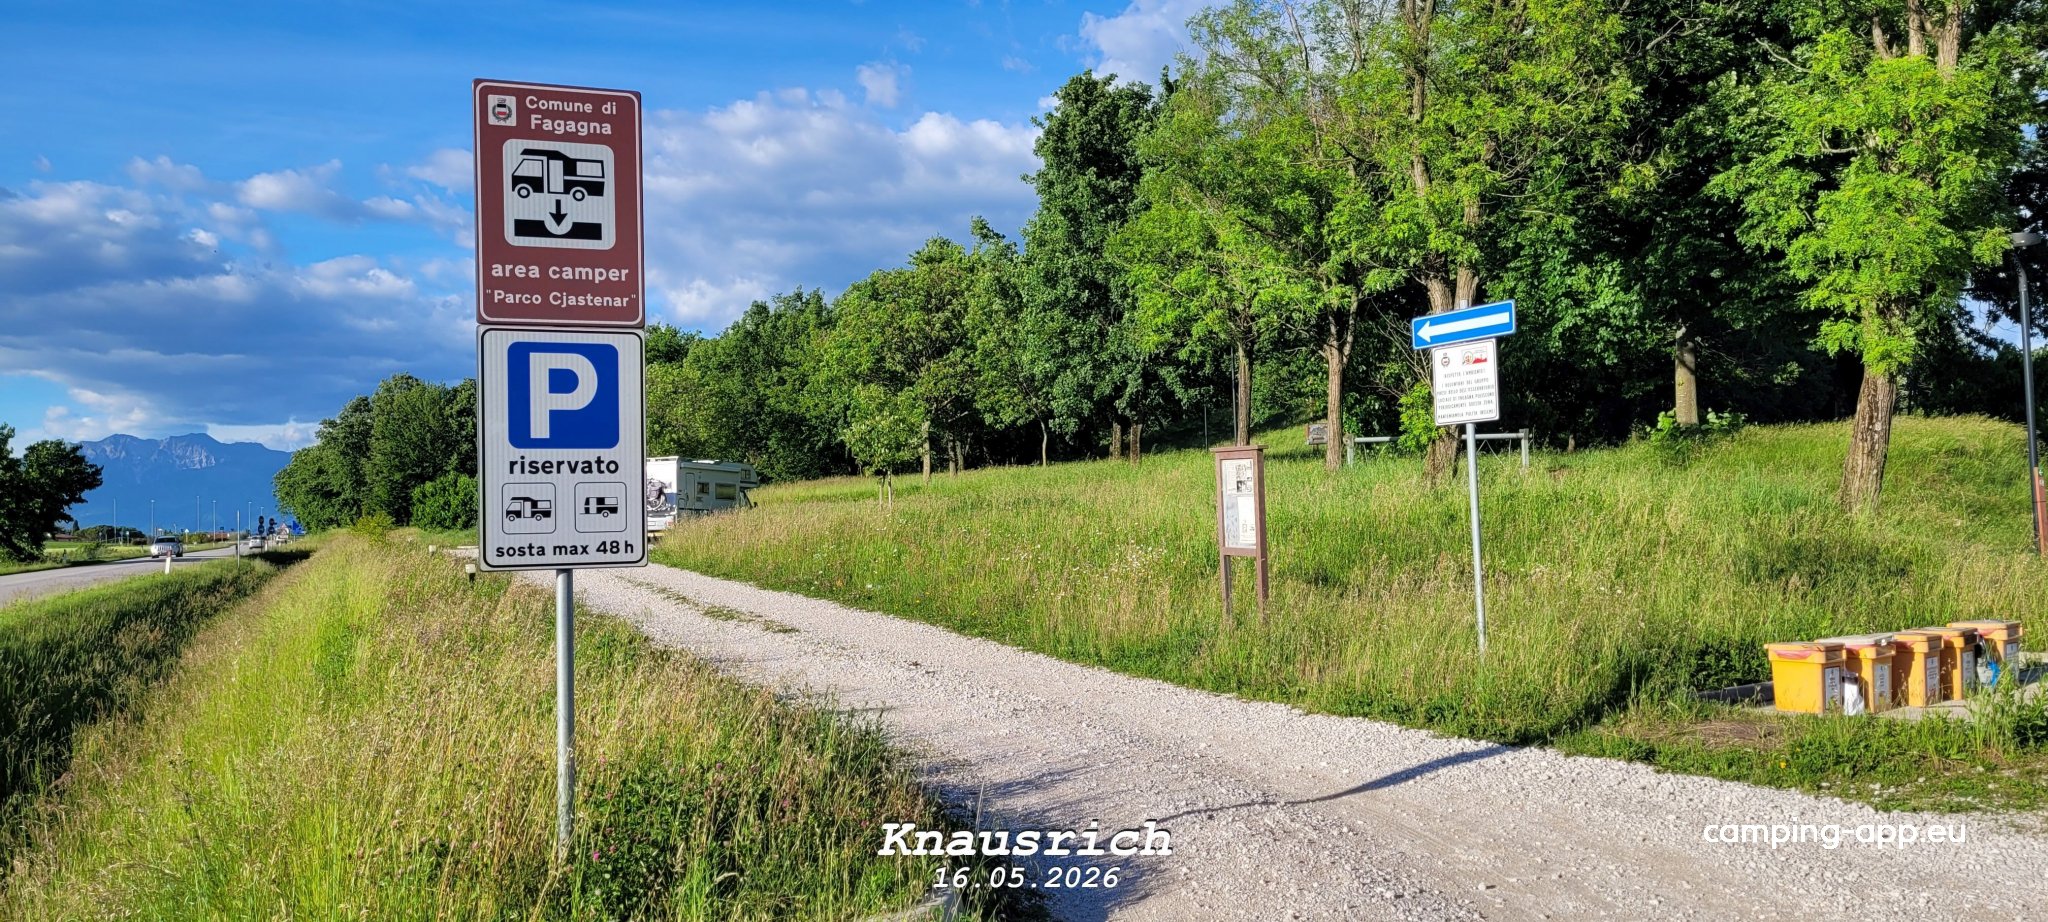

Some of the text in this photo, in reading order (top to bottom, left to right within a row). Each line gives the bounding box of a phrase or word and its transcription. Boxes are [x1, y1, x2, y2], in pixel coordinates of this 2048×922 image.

[525, 95, 617, 115] Comune di
[530, 114, 612, 136] Fagagna
[491, 263, 629, 283] area camper
[529, 352, 598, 439] P
[508, 455, 620, 475] riservato
[495, 542, 546, 558] sosta
[552, 543, 589, 556] max
